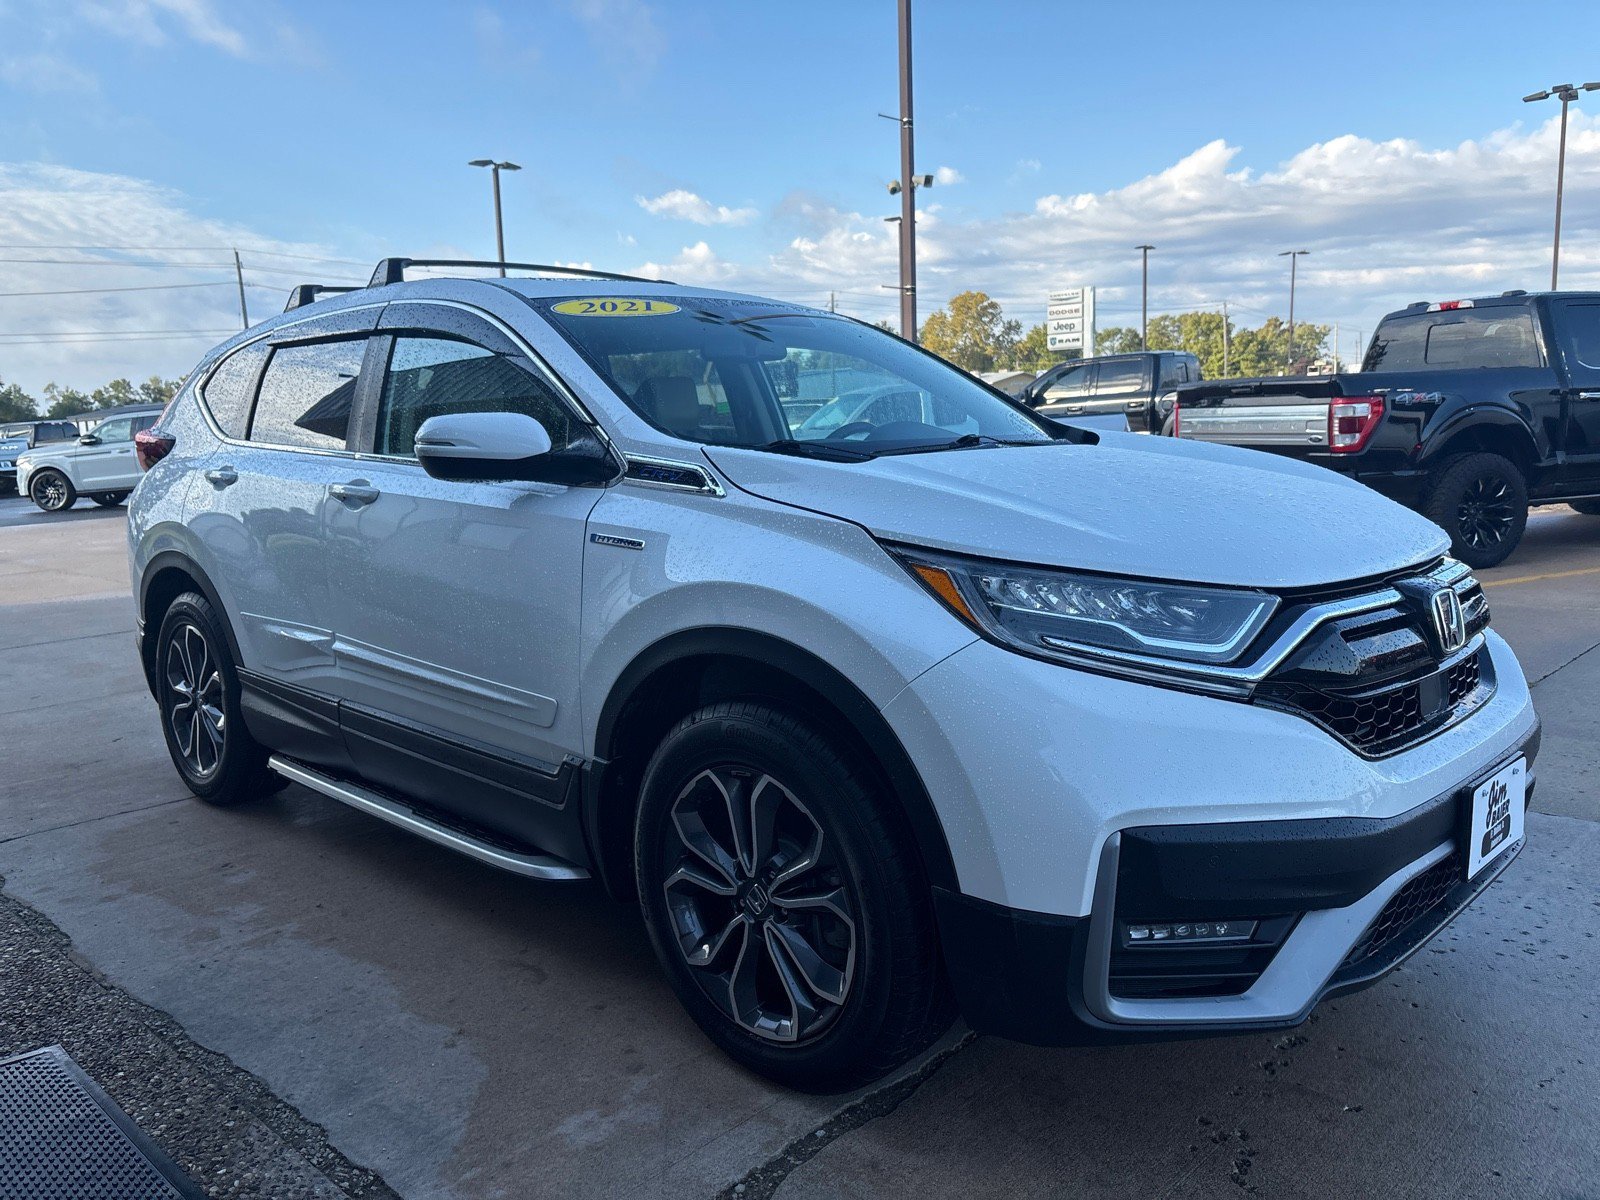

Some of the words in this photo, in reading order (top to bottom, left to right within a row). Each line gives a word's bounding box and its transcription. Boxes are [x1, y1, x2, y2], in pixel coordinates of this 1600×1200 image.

[579, 301, 657, 314] 2021
[1049, 308, 1080, 316] DODGE
[1053, 321, 1075, 331] Jeep
[595, 535, 643, 548] HYBRID
